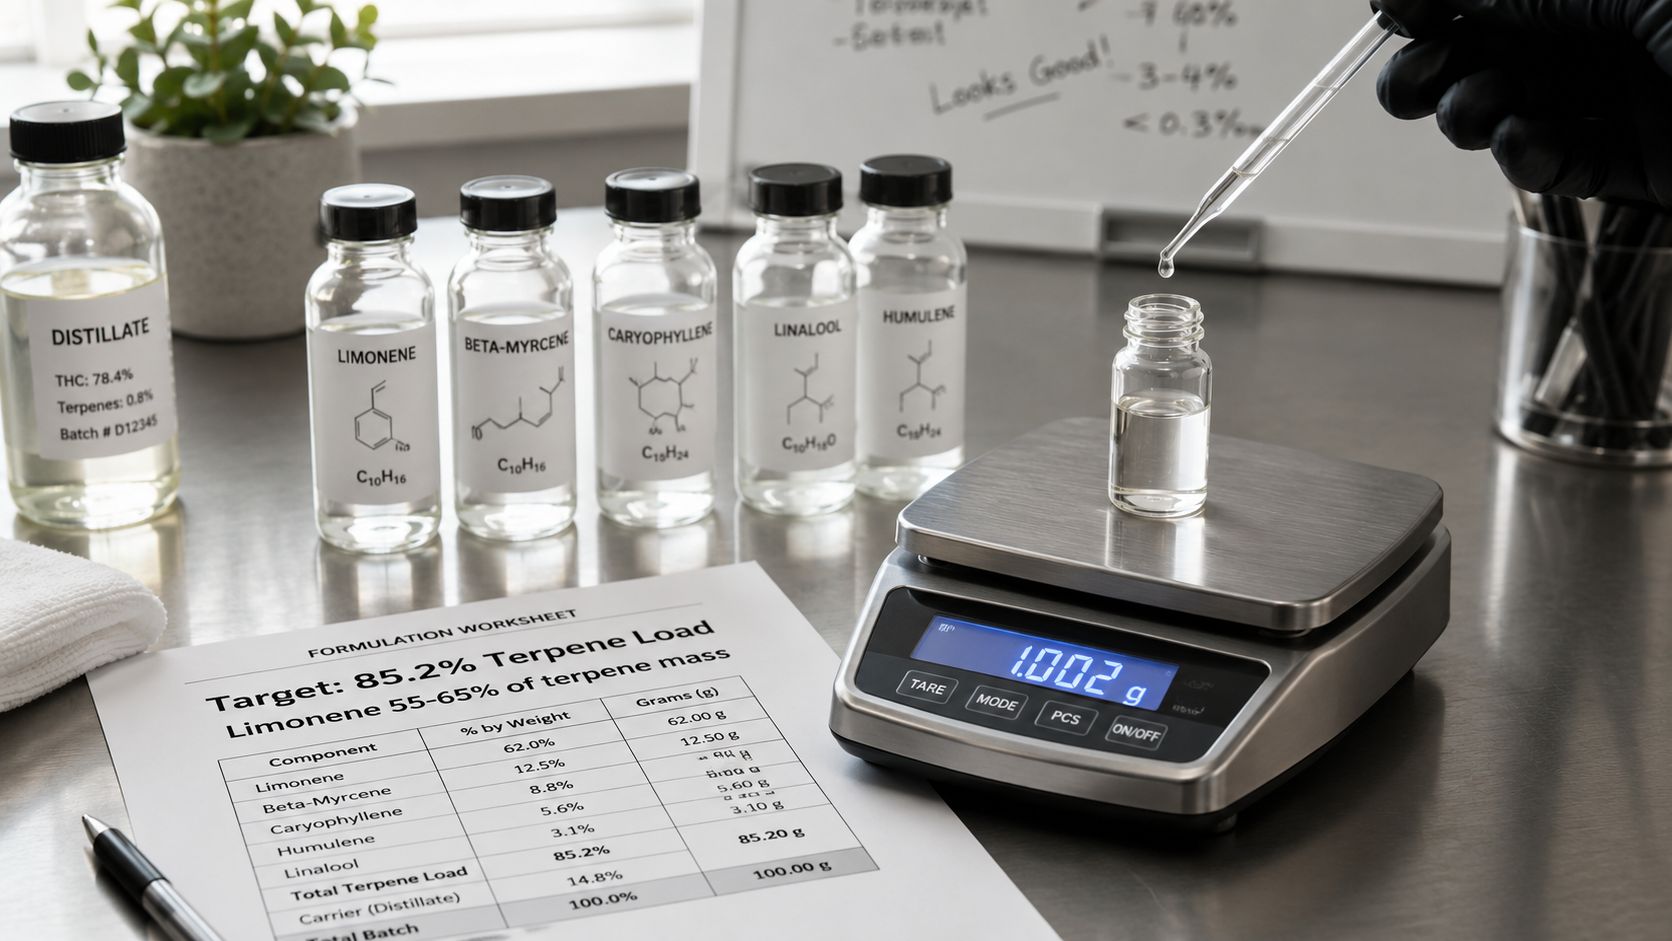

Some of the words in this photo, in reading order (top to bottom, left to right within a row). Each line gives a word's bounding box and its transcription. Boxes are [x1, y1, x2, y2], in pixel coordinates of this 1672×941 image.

[929, 69, 1017, 115] Looks
[1029, 34, 1112, 86] Good!
[773, 320, 842, 337] LINALOOL
[882, 305, 954, 324] HUMULENE
[52, 317, 150, 346] DISTILLATE
[464, 331, 569, 354] BETA-MYRCENE
[608, 321, 712, 345] CARYOPHYLLENE
[338, 346, 416, 364] LIMONENE
[55, 374, 89, 388] THC:
[92, 368, 134, 386] 78.4%
[57, 399, 124, 416] Terpenes:
[126, 389, 154, 407] 0.8%
[60, 427, 99, 441] Batch
[103, 427, 111, 438] #
[115, 414, 158, 437] D12345
[308, 628, 453, 659] FORMULATION
[457, 608, 577, 634] WORKSHEET
[206, 681, 344, 712] Target:
[354, 657, 477, 690] 85.2%
[483, 638, 627, 668] Terpene
[632, 619, 715, 645] Load
[1011, 645, 1123, 696] 1.002
[1124, 687, 1148, 707] g
[226, 705, 382, 739] Limonene
[388, 683, 500, 713] 55-65%
[506, 676, 535, 693] of
[541, 661, 652, 688] terpene
[658, 649, 731, 669] mass
[910, 678, 947, 697] TARE
[976, 692, 1020, 713] MODE
[269, 742, 378, 769] Component
[460, 725, 478, 736] %
[481, 723, 503, 733] by
[506, 711, 571, 730] Weight
[636, 691, 692, 708] Grams
[696, 686, 719, 699] (g)
[1051, 709, 1081, 727] PCS
[1112, 723, 1163, 744] ON/OFF
[255, 772, 345, 794] Limonene
[503, 738, 556, 754] 62.0%
[668, 712, 712, 727] 62.00
[715, 709, 727, 720] g
[263, 785, 392, 815] Beta-Myrcene
[514, 758, 566, 774] 12.5%
[681, 732, 725, 747] 12.50
[728, 730, 740, 741] g
[270, 806, 404, 836] Caryophyllene
[529, 780, 574, 795] 8.8%
[277, 834, 376, 857] Humulene
[540, 802, 584, 816] 5.6%
[717, 780, 754, 793] 5.60
[758, 777, 770, 788] g
[284, 858, 360, 880] Linalool
[551, 824, 595, 838] 3.1%
[730, 801, 768, 815] 3.10
[772, 800, 785, 811] g
[738, 828, 789, 844] 85.20
[792, 827, 806, 838] g
[291, 886, 339, 902] Total
[342, 875, 420, 896] Terpene
[423, 865, 469, 882] Load
[553, 845, 610, 861] 85.2%
[753, 862, 815, 881] 100.00
[818, 860, 832, 872] g
[299, 906, 363, 926] Carrier
[367, 891, 462, 916] (Distillate)
[567, 870, 624, 887] 14.8%
[362, 923, 420, 941] Batch
[568, 891, 639, 911] 100.0%
